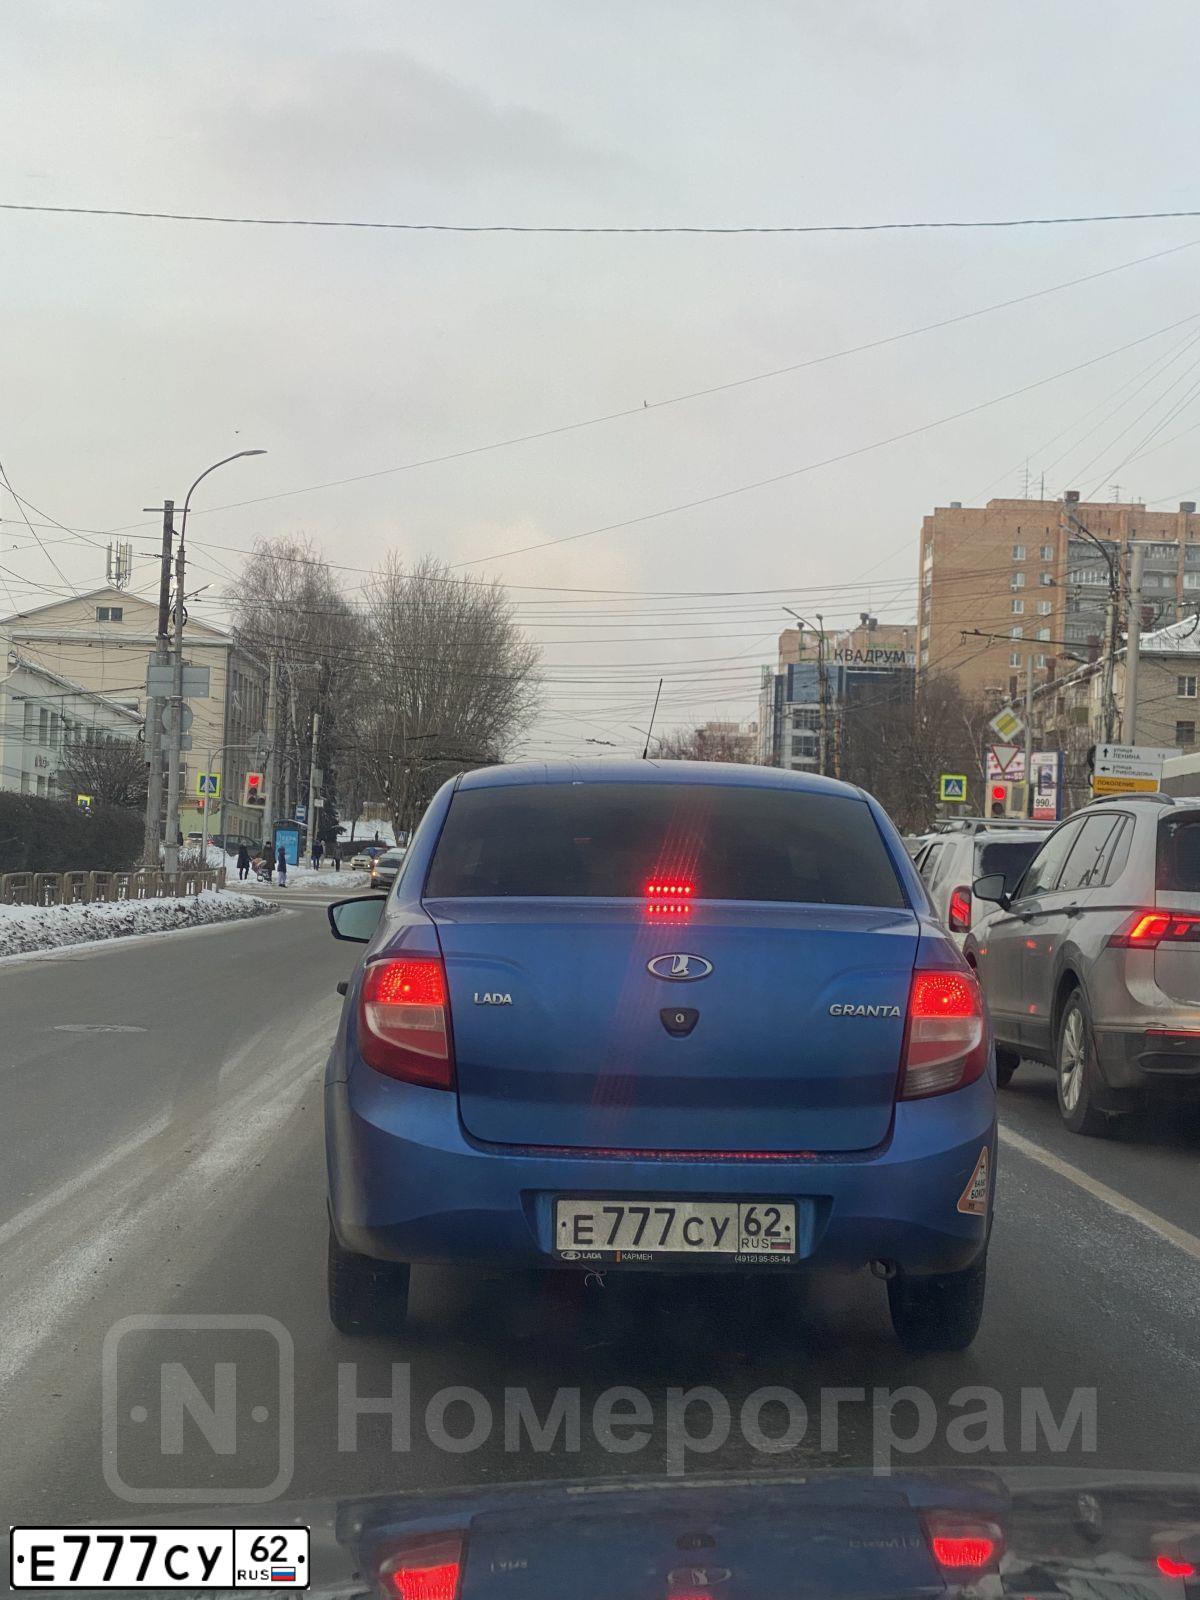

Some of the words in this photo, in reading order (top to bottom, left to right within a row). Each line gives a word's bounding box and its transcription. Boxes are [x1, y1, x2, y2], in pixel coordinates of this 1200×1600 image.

[834, 648, 905, 664] КВАДРУМ
[1112, 753, 1141, 761] ЛЕНИНА
[474, 992, 513, 1006] LADA
[829, 1003, 901, 1018] GRANTA
[573, 1206, 730, 1247] Е777СУ
[744, 1206, 781, 1237] 62
[741, 1238, 770, 1249] RUS
[582, 1252, 602, 1260] LADA
[622, 1252, 653, 1261] КАРМЕН
[734, 1255, 758, 1263] (4912)
